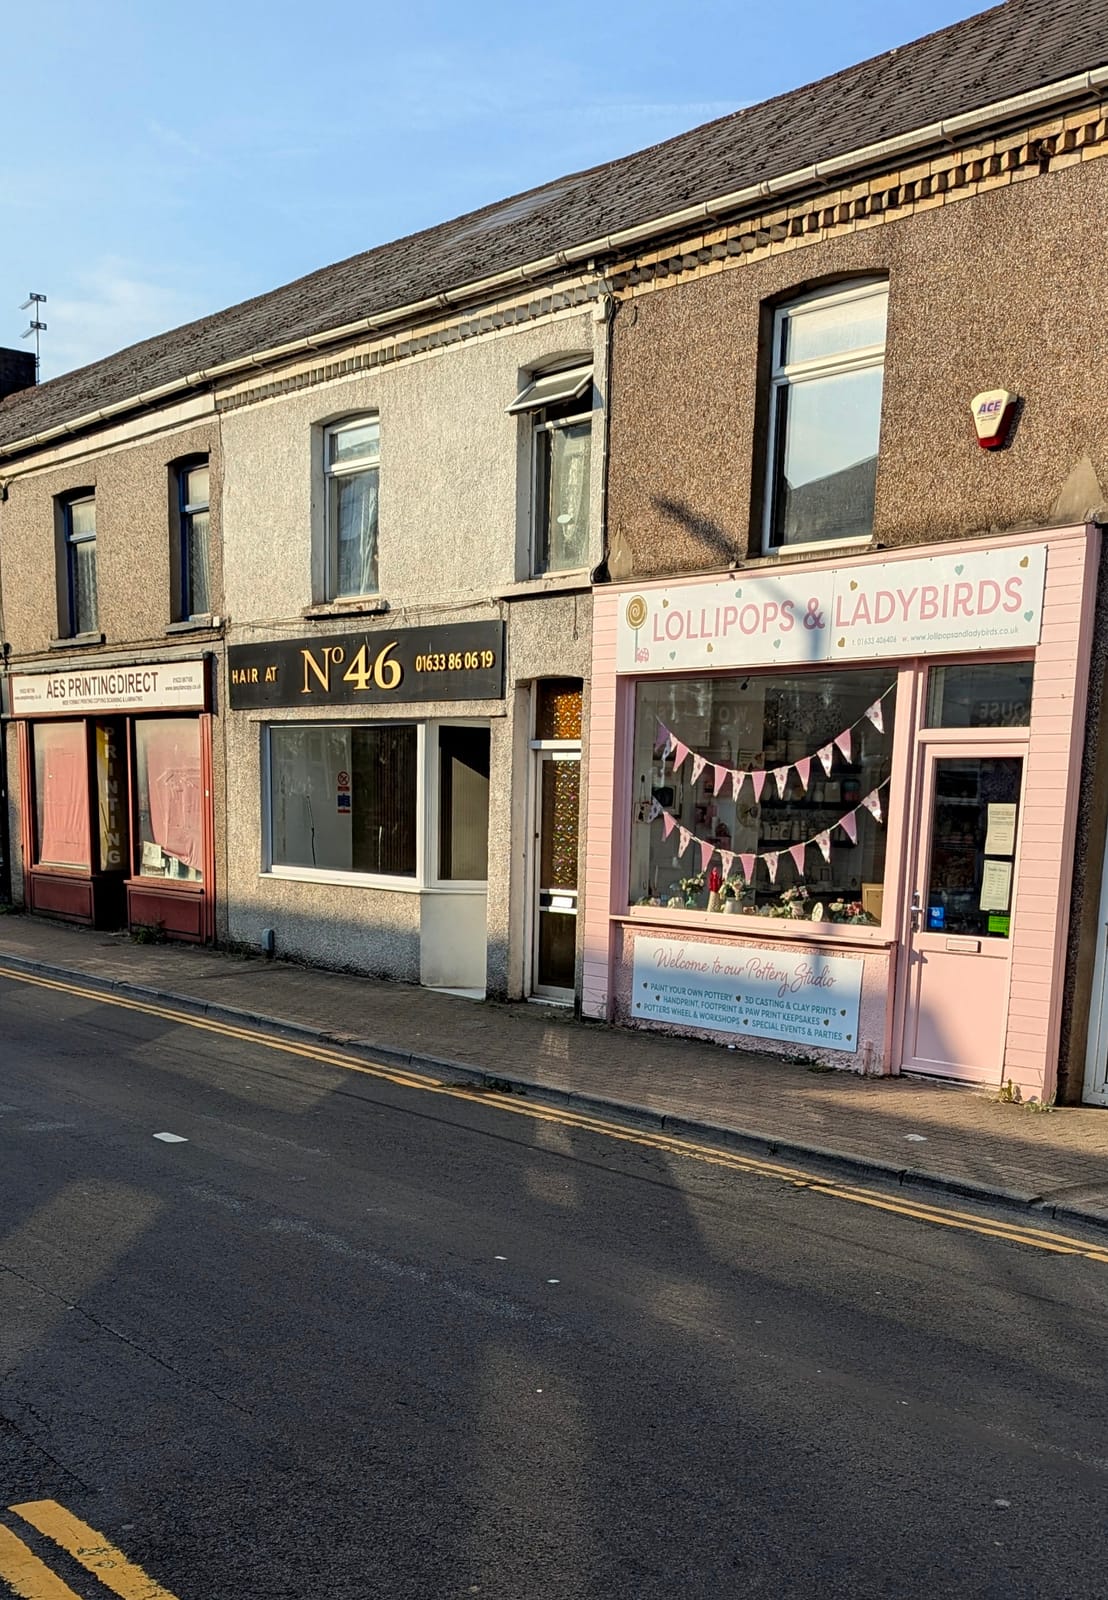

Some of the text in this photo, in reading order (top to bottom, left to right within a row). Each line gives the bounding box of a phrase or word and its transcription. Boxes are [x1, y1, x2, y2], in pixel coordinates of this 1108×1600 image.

[978, 400, 1001, 414] ACE
[652, 576, 1023, 642] LOLLIPOPS & LADYBIRDS
[232, 667, 258, 684] HAIR
[265, 666, 278, 682] AT
[415, 653, 446, 672] 01633
[46, 680, 66, 699] AES
[653, 947, 836, 998] Welcome to our Pottery Studio
[650, 983, 733, 1001] PAINT YOUR OWN POTTERY
[644, 1003, 670, 1014] POTTERS
[671, 1007, 692, 1018] WHEEL
[699, 1012, 740, 1025] WORKSHOPS
[701, 1001, 737, 1013] FOOTPRINT
[738, 1006, 744, 1014] &
[745, 1007, 760, 1016] PAW
[761, 1009, 781, 1020] PRINT
[783, 1013, 820, 1025] KEEPSAKES
[744, 995, 837, 1016] 3D CASTING & CLAY PRINTS
[752, 1019, 842, 1041] SPECIAL EVENTS & PARTIES
